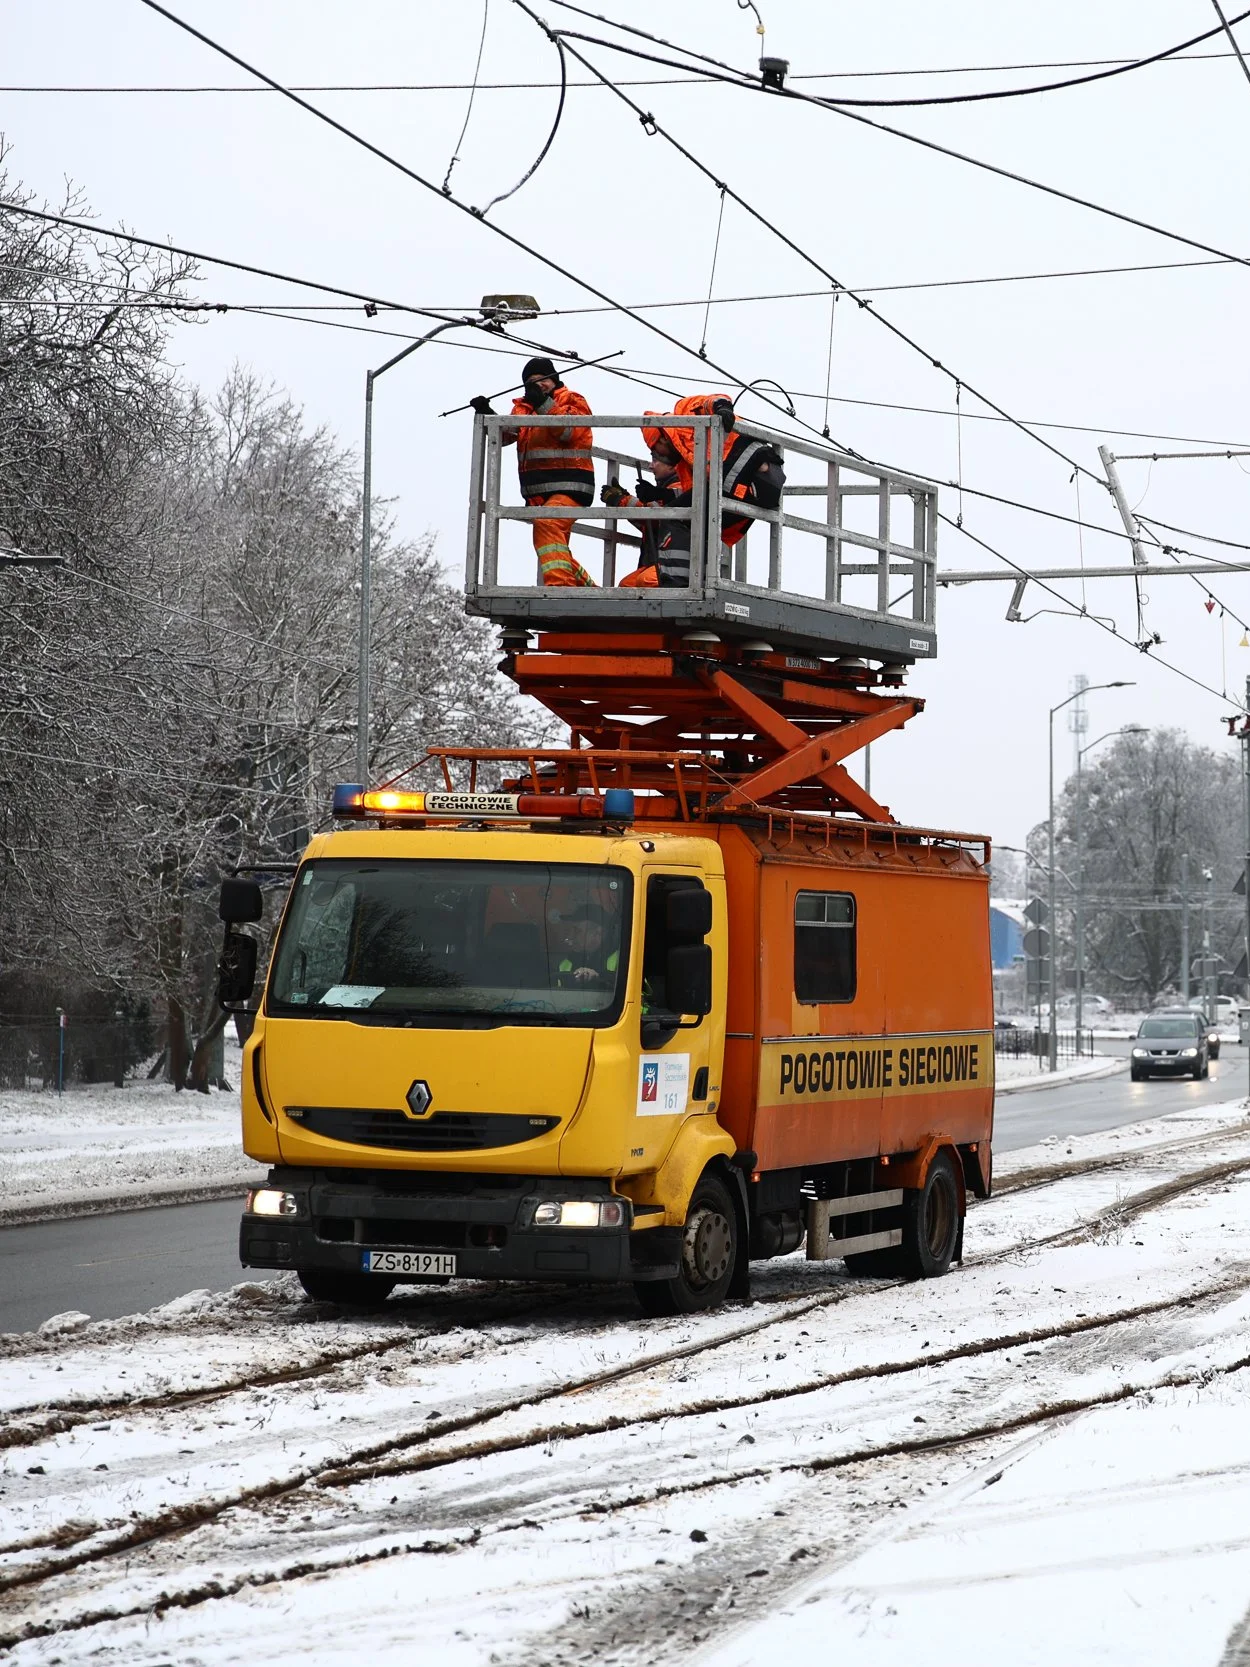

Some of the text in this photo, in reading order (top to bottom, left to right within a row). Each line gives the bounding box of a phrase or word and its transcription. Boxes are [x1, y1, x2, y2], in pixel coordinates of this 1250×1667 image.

[780, 1044, 979, 1094] POGOTOWIE SIECIOWE
[664, 1092, 678, 1109] 161
[372, 1253, 454, 1274] ZS 8191H
